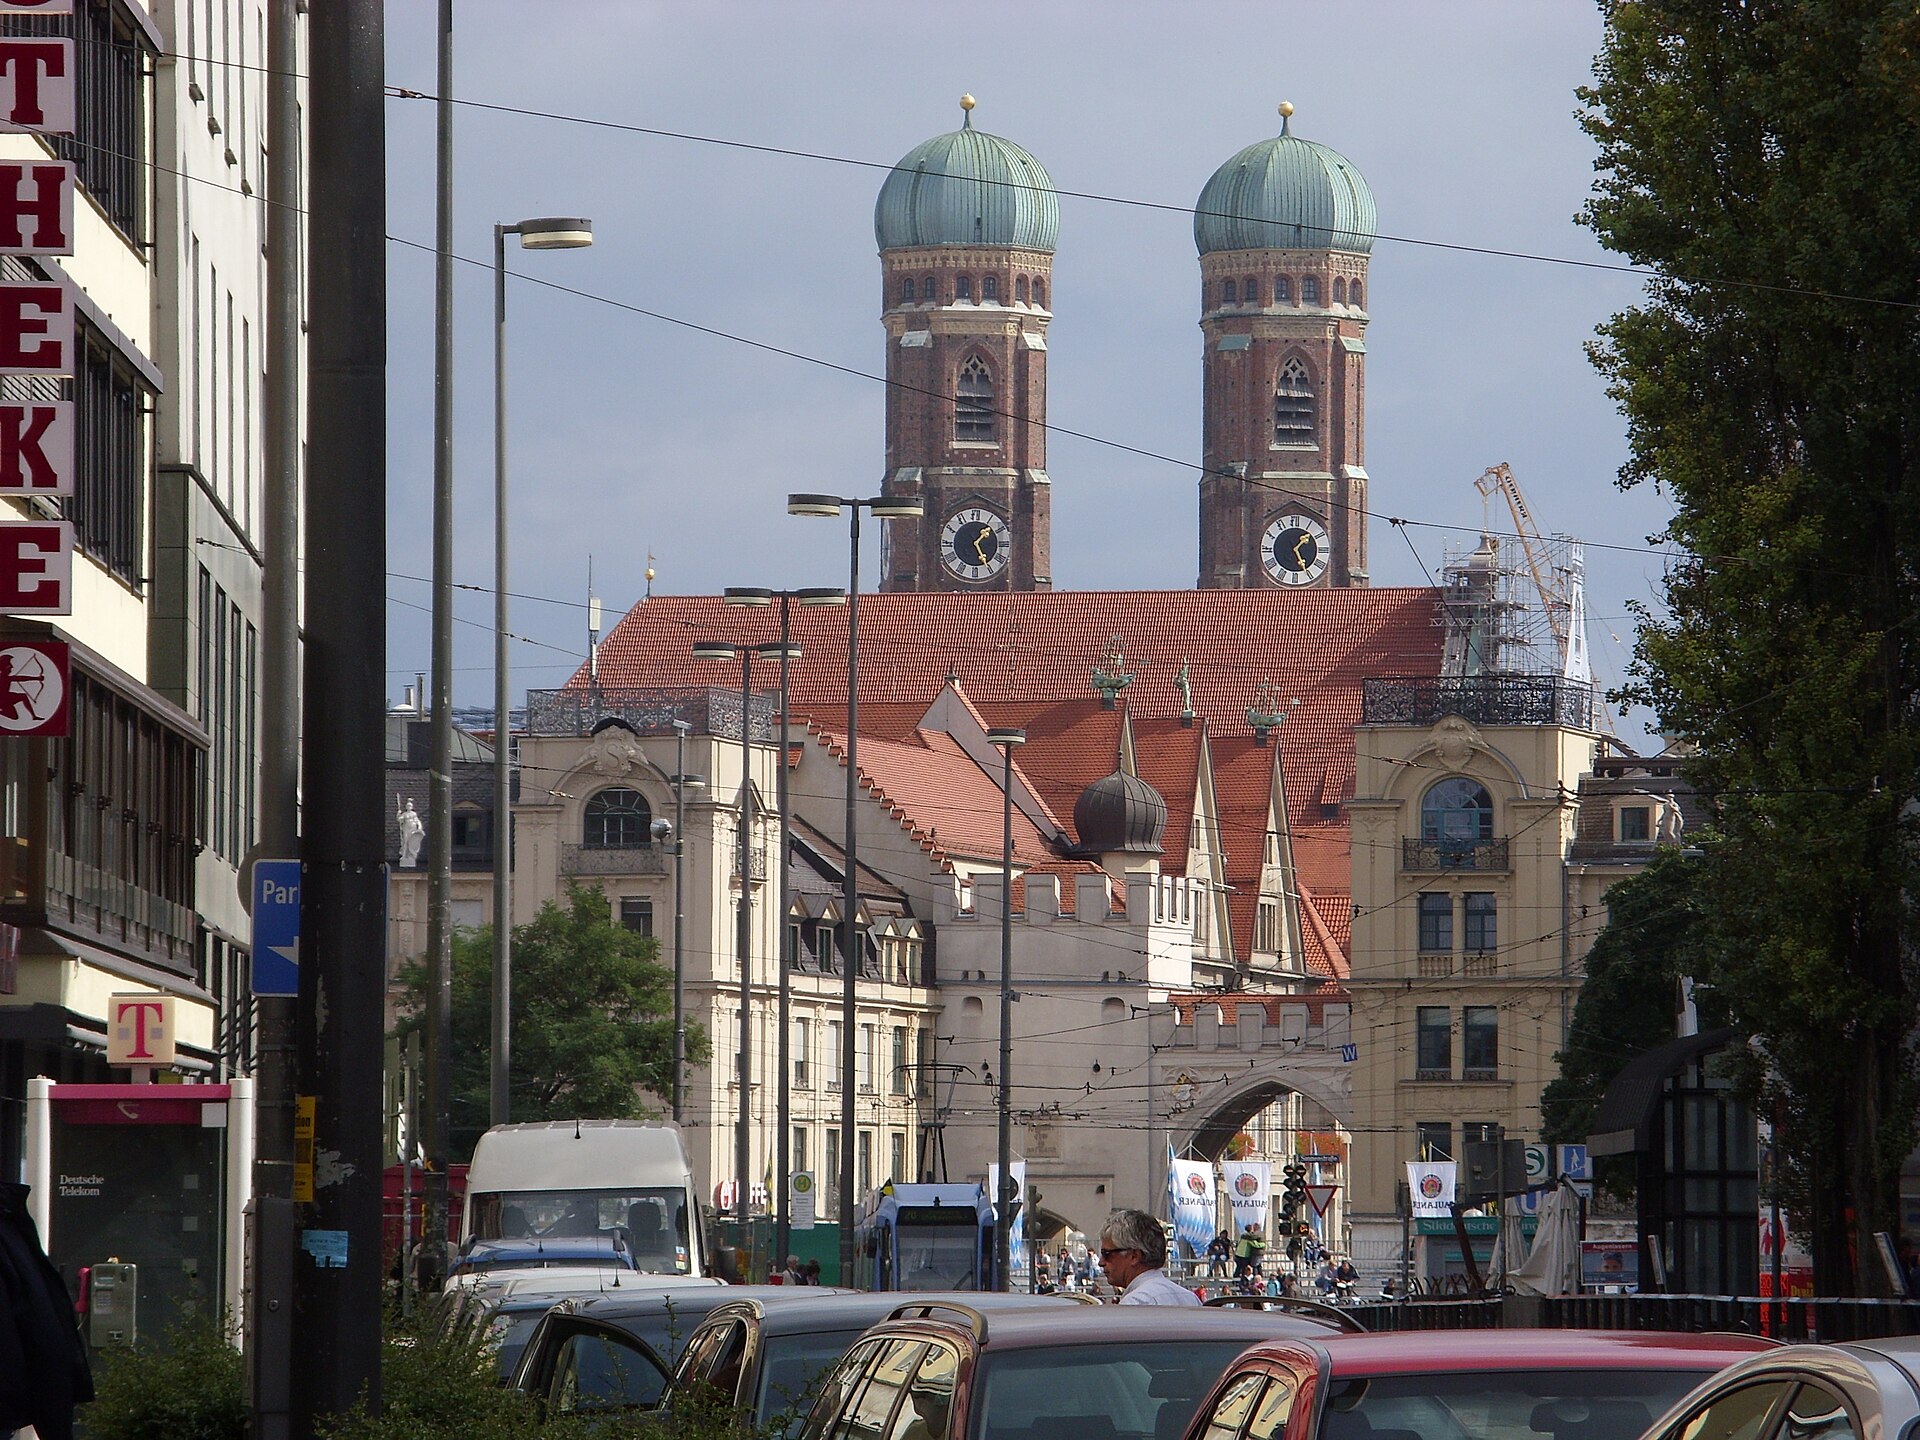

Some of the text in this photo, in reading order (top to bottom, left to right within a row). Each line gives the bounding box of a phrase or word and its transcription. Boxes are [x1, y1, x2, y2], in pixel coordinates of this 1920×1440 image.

[0, 0, 65, 608] THEKE
[117, 1003, 163, 1058] T
[59, 1186, 100, 1196] Telekom
[60, 1174, 105, 1185] Deutsche
